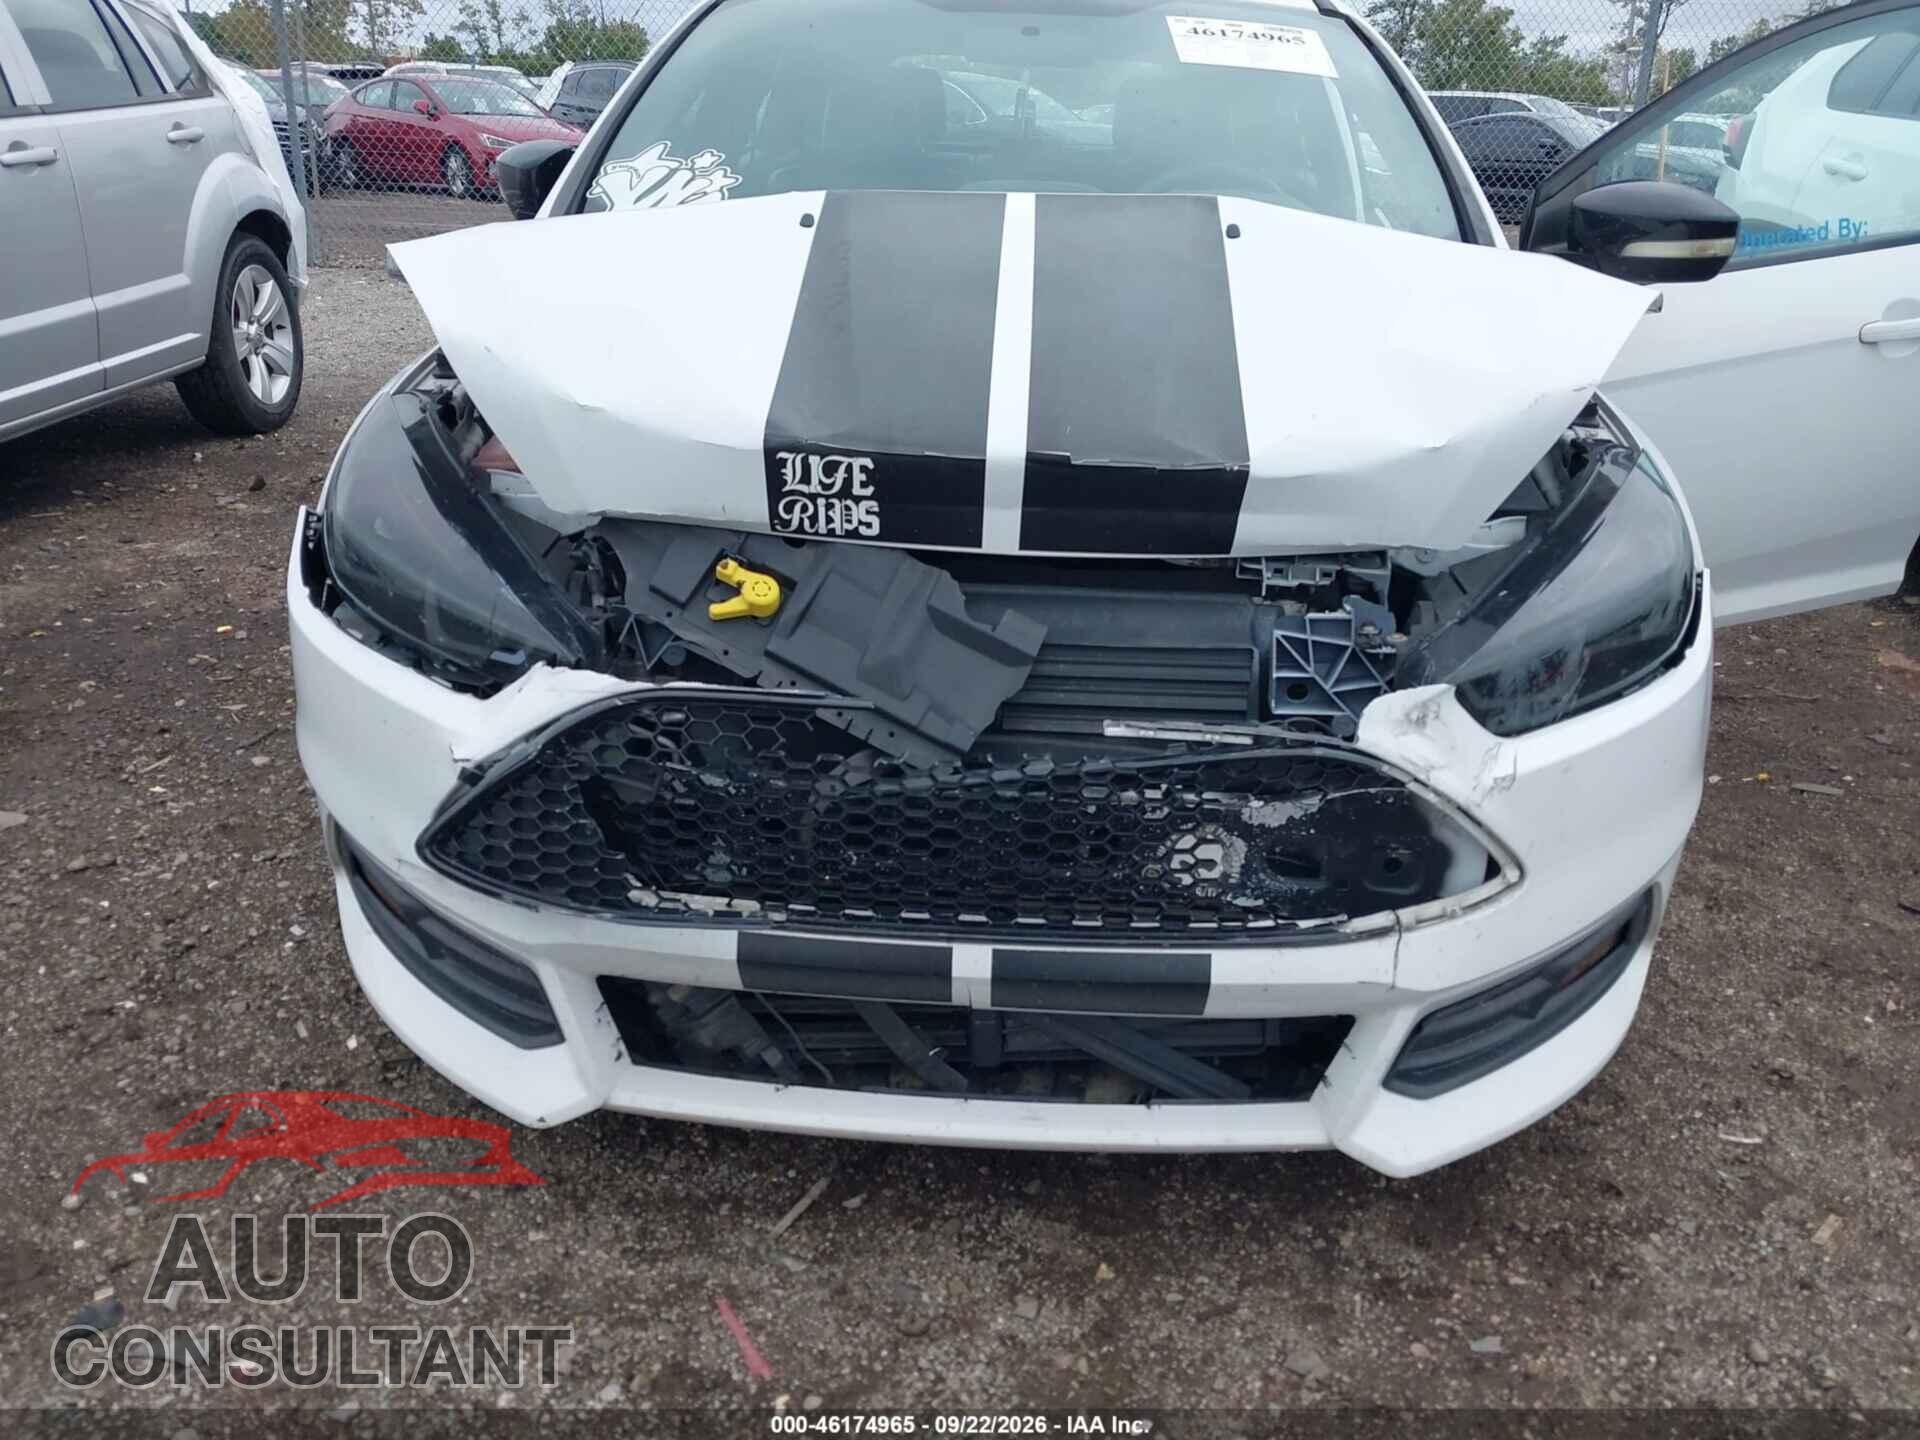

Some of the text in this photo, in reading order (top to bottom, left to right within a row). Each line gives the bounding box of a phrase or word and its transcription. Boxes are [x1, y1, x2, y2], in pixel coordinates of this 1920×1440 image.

[1186, 26, 1306, 45] 46174965
[1838, 217, 1868, 241] By:
[776, 452, 875, 496] LIFE
[774, 496, 880, 536] RIPS
